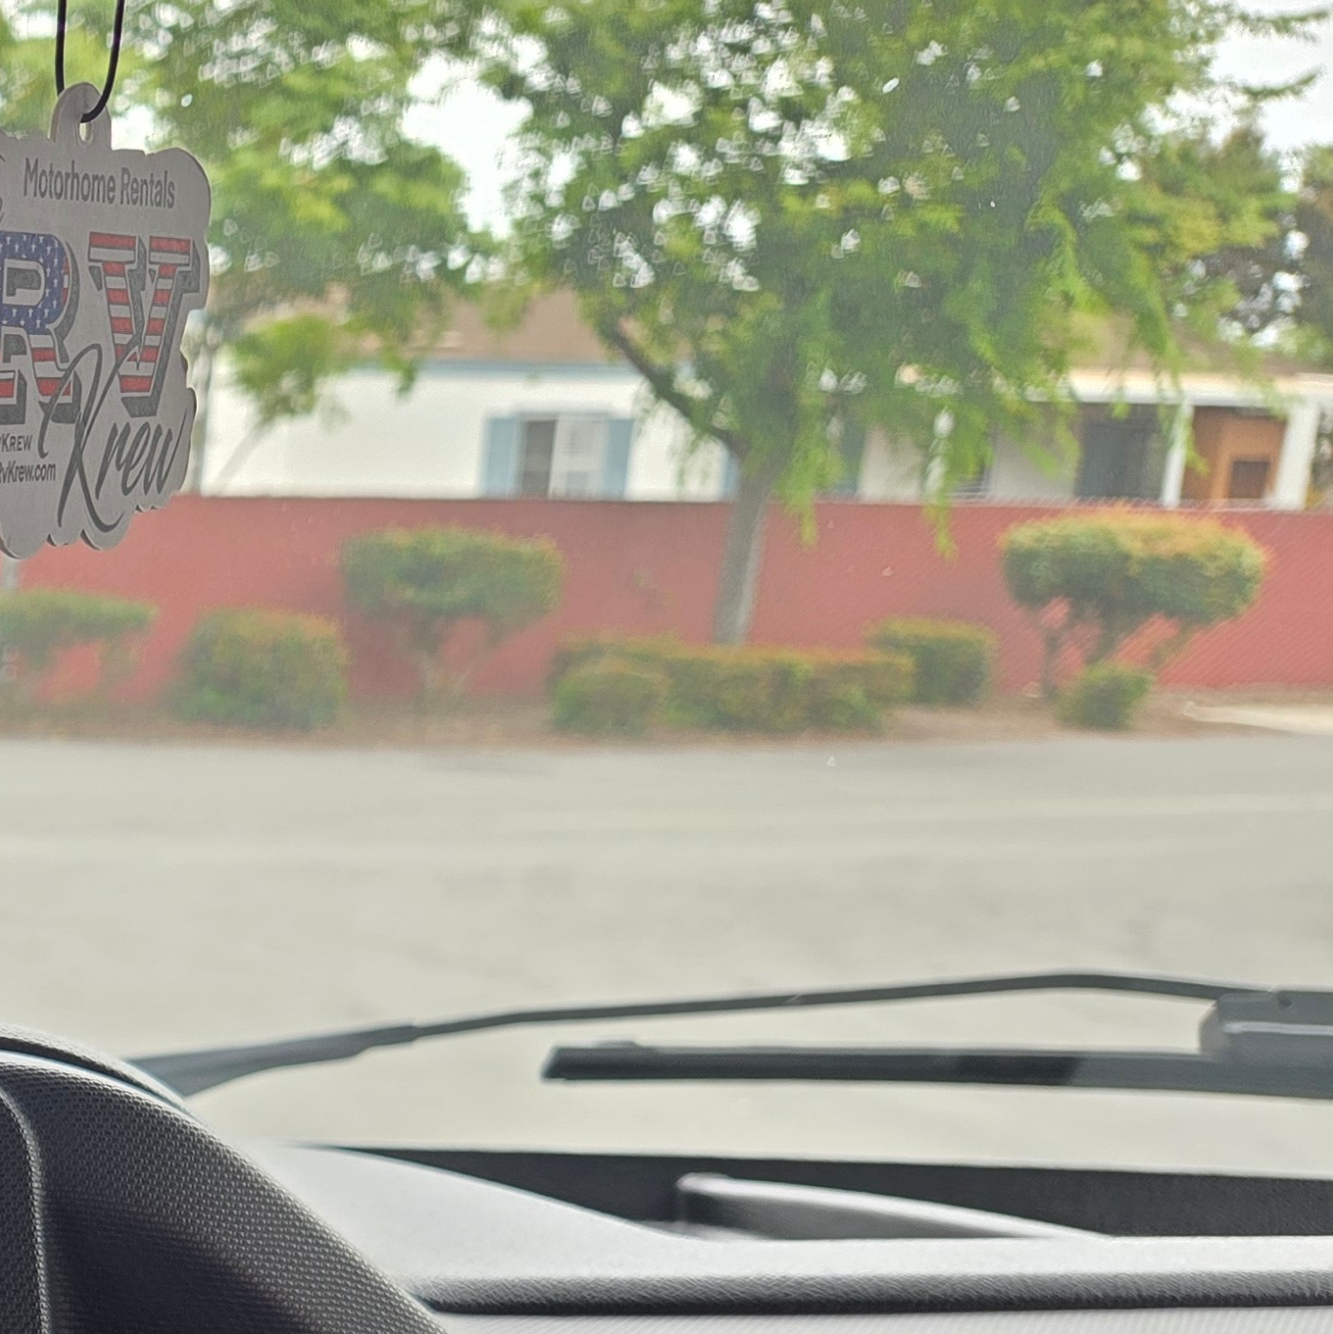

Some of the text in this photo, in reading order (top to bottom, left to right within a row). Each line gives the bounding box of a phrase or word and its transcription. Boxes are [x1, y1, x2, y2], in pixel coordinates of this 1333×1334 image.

[24, 157, 176, 209] Motorhome Rentals
[37, 343, 187, 533] Krew
